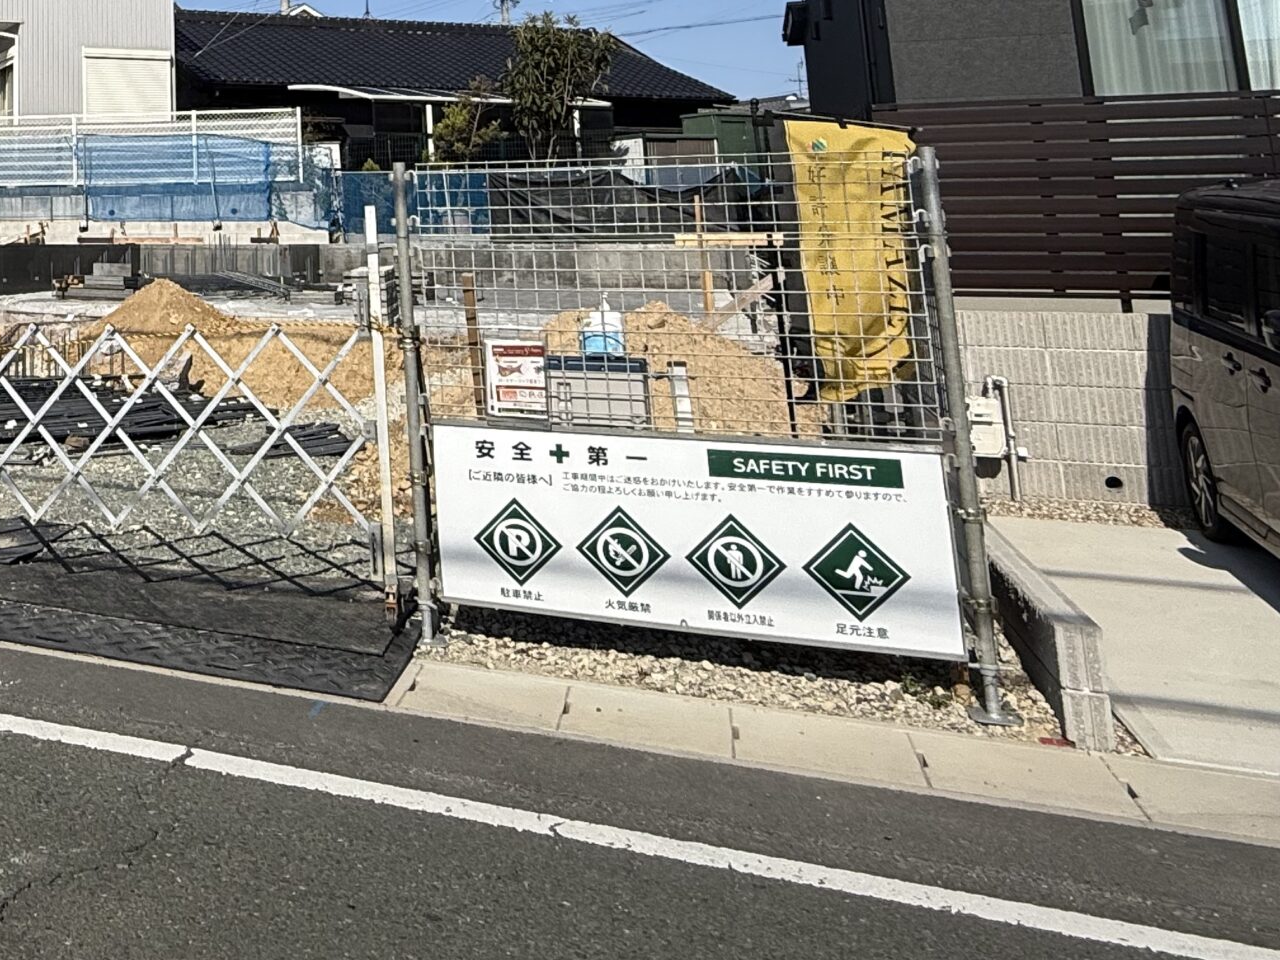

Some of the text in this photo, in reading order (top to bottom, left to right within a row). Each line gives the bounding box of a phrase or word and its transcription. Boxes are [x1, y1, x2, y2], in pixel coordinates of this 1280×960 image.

[733, 457, 876, 481] SAFETY FIRST
[500, 587, 545, 602] 駐車禁止
[605, 599, 652, 614] 火気厳禁
[707, 609, 775, 627] 関係者以外立入禁止
[835, 623, 890, 640] 足元注意
